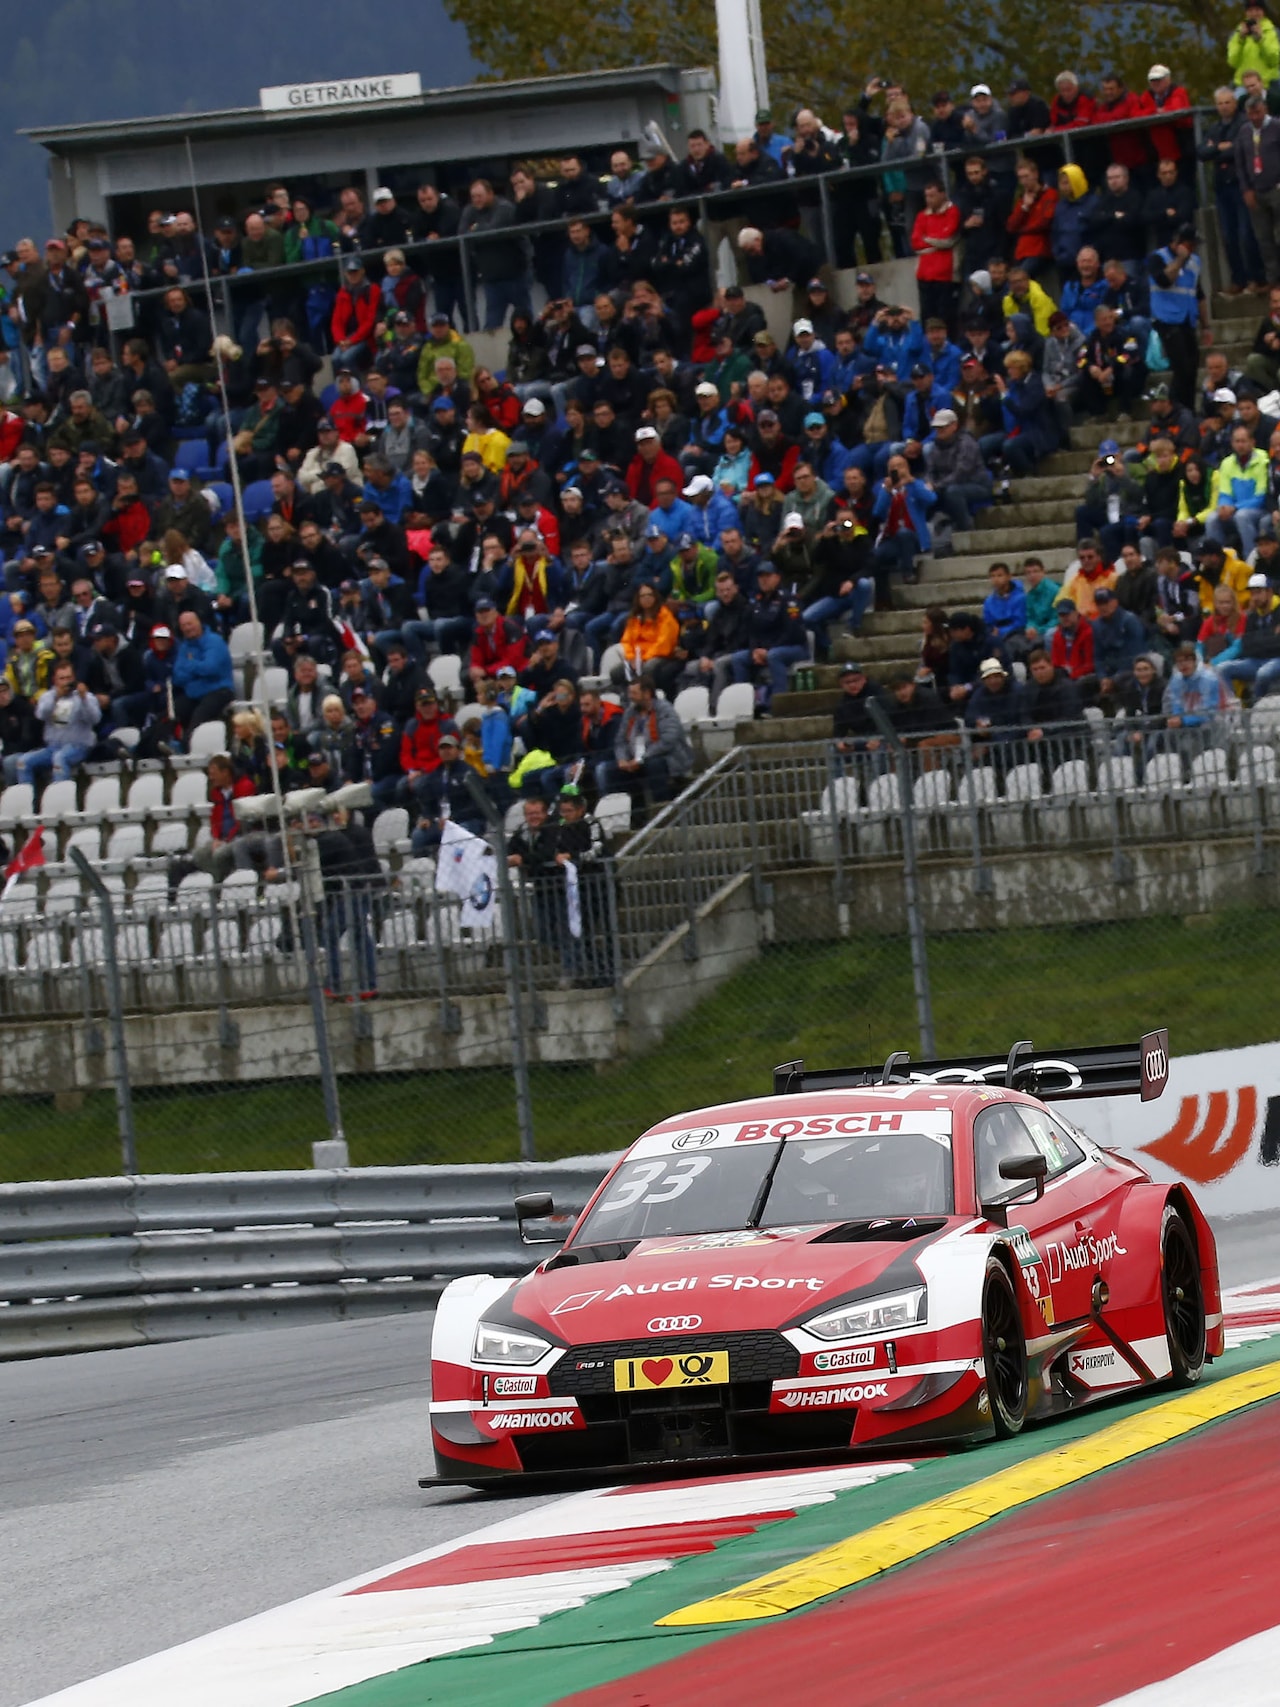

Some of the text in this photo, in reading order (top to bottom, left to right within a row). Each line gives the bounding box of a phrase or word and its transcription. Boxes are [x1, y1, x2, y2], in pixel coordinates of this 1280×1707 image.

[734, 1113, 902, 1142] BOSCH
[598, 1155, 713, 1213] 33
[1062, 1231, 1127, 1272] Audi Sport
[604, 1274, 825, 1302] Audi Sport
[829, 1351, 872, 1367] Castrol
[503, 1378, 535, 1392] Castrol
[628, 1361, 635, 1388] I
